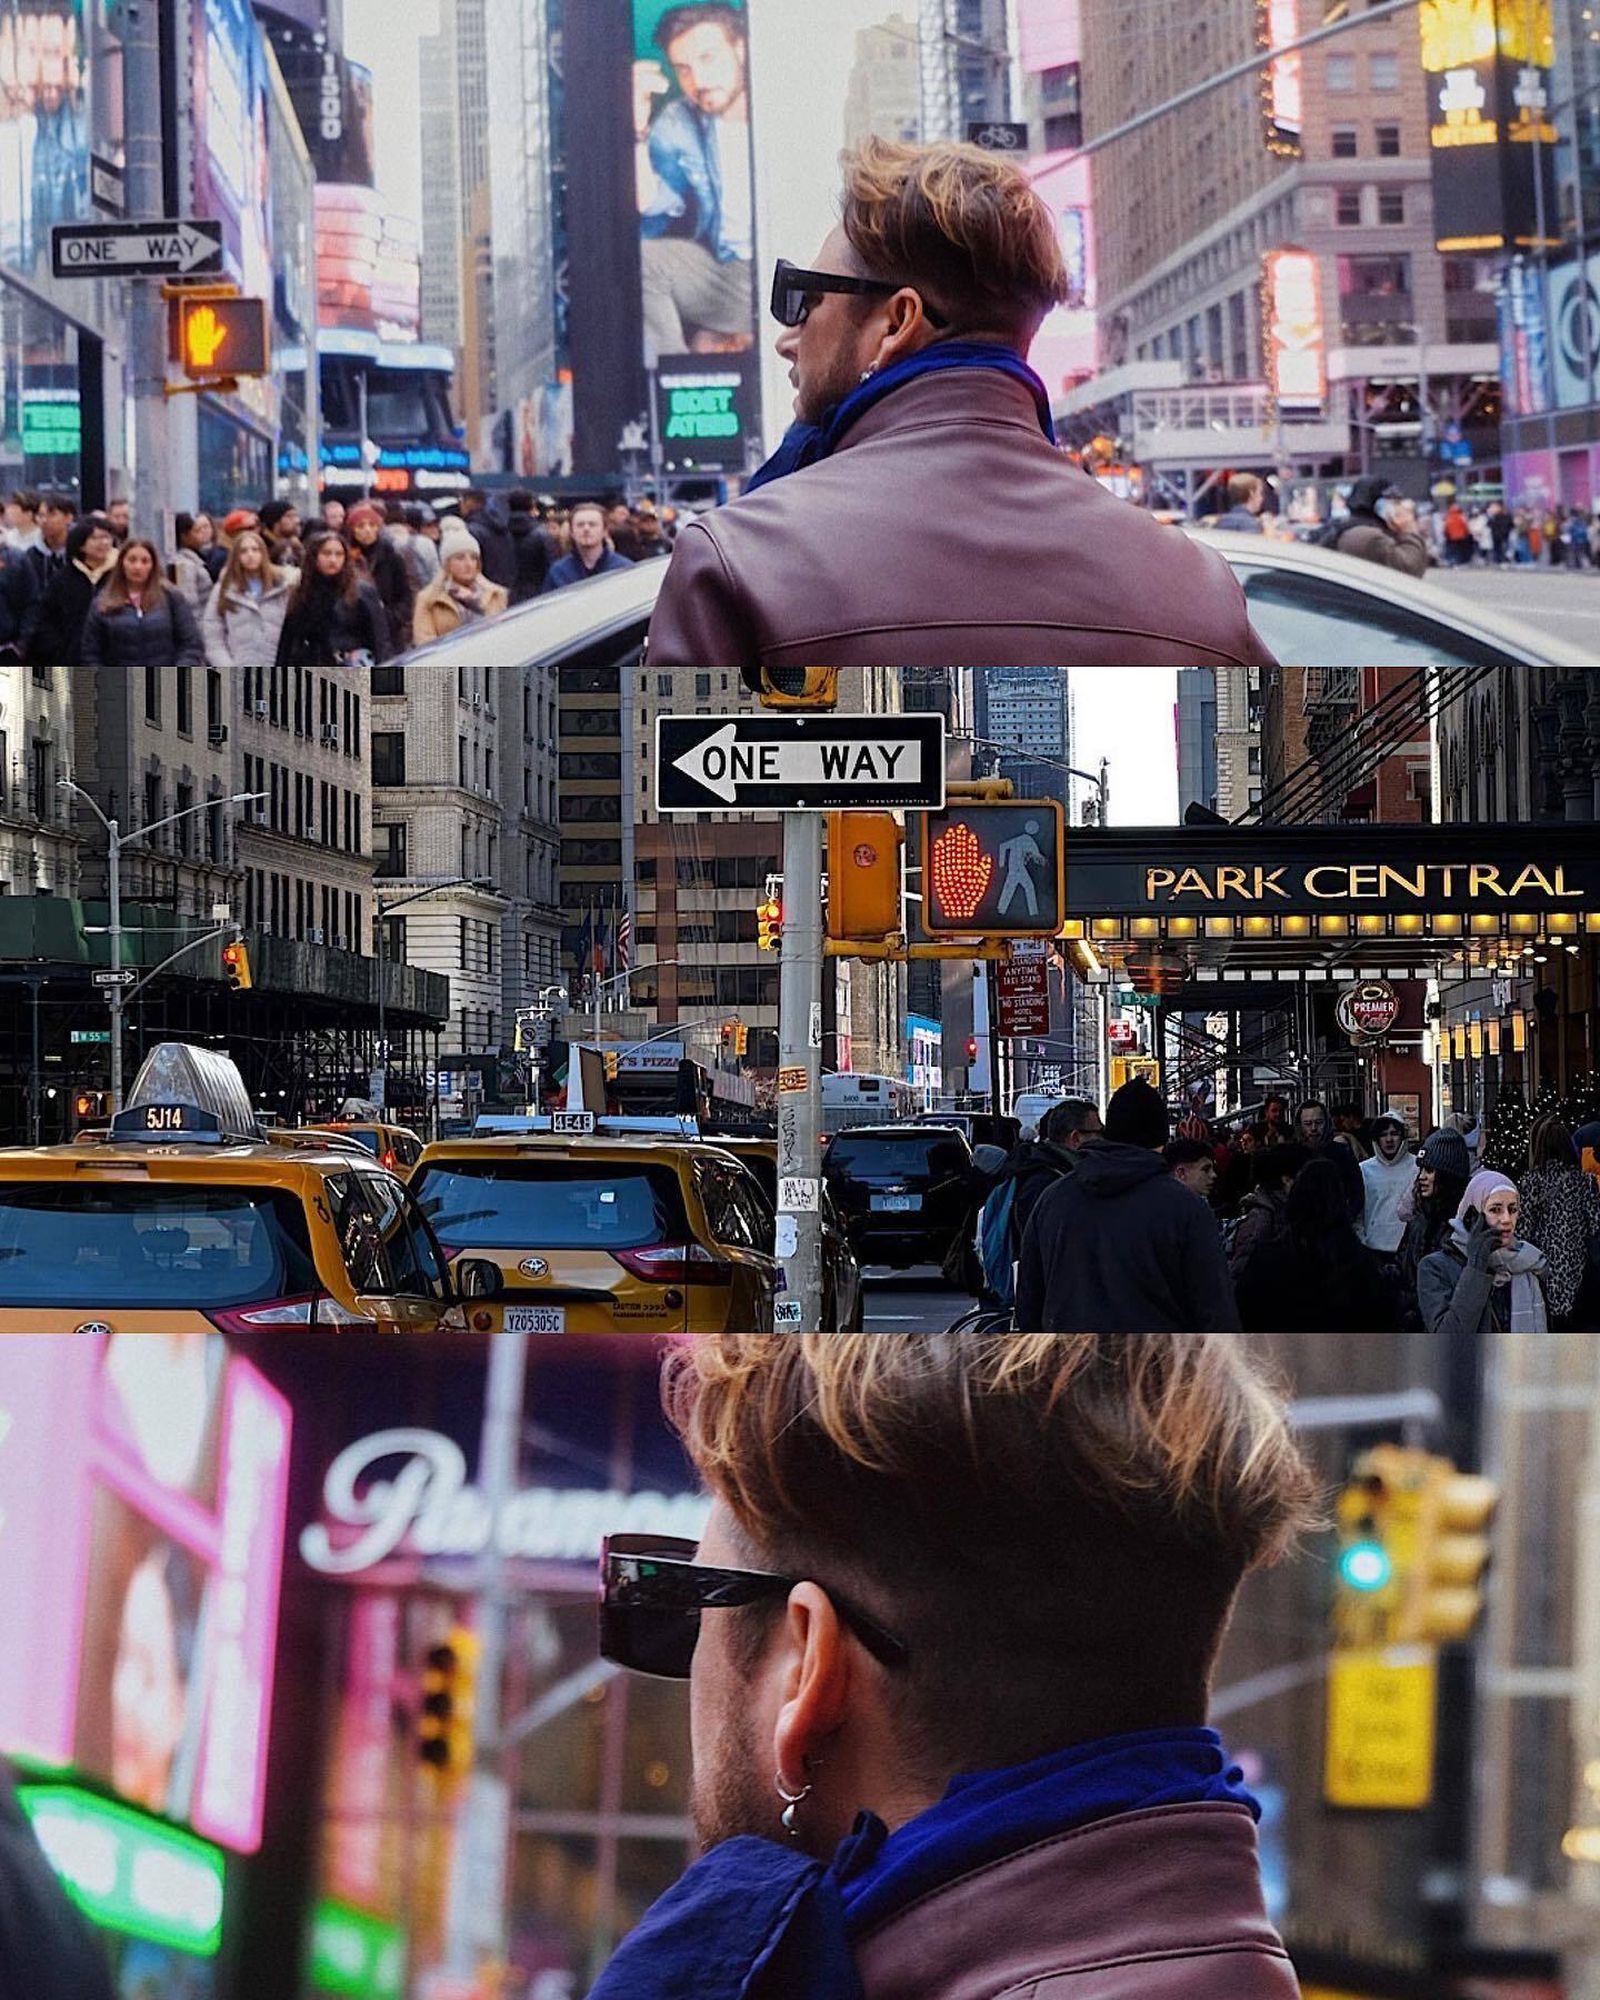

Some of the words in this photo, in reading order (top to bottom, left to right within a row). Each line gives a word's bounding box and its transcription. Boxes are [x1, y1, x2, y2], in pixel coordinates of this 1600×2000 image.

[67, 240, 117, 262] ONE
[147, 238, 199, 259] WAY
[702, 745, 780, 780] ONE
[820, 745, 905, 780] WAY
[1147, 865, 1291, 900] PARK
[1303, 864, 1585, 898] CENTRAL
[1012, 958, 1044, 966] STANDING
[1005, 965, 1039, 976] ANYTIME
[1021, 975, 1042, 984] STAND
[1002, 1000, 1012, 1008] NO
[1014, 998, 1045, 1007] STANDING
[1353, 1002, 1395, 1012] PREMIER
[89, 1031, 100, 1041] 55
[146, 1107, 182, 1129] 5J14
[508, 1314, 560, 1332] Y205305C
